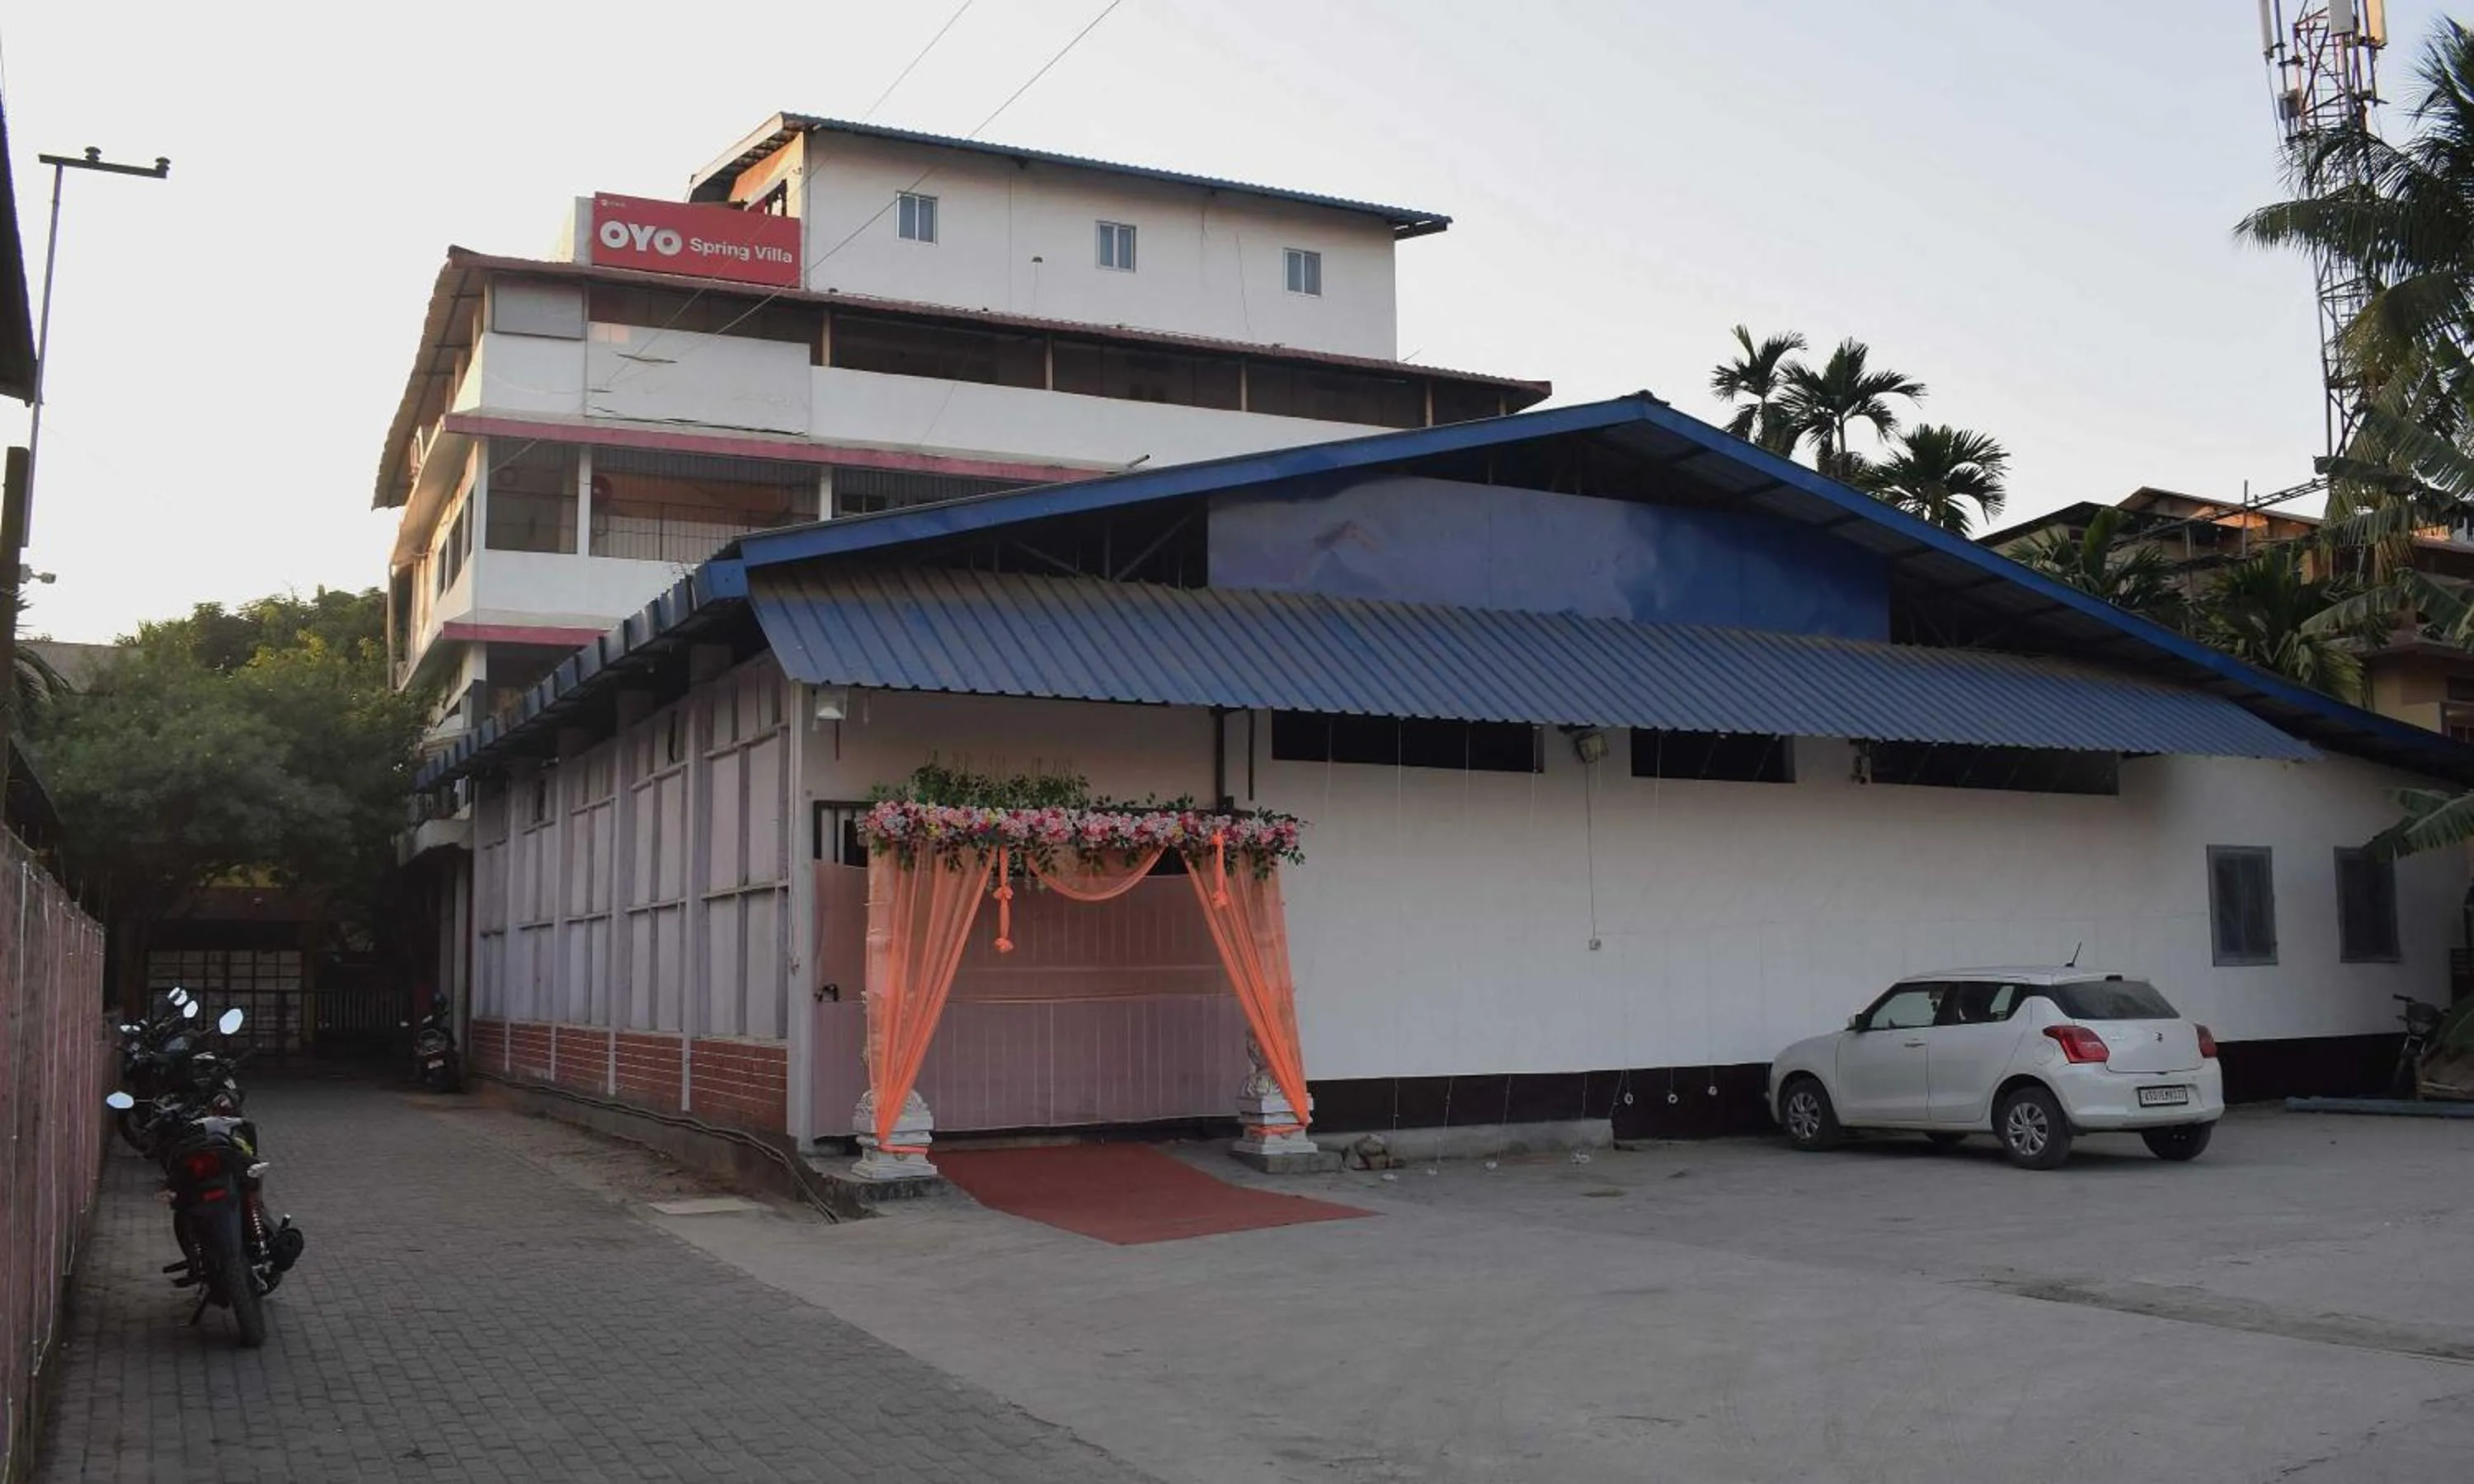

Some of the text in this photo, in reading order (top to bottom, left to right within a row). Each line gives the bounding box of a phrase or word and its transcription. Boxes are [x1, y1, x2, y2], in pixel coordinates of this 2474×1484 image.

[600, 220, 793, 263] OYO Spring Villa
